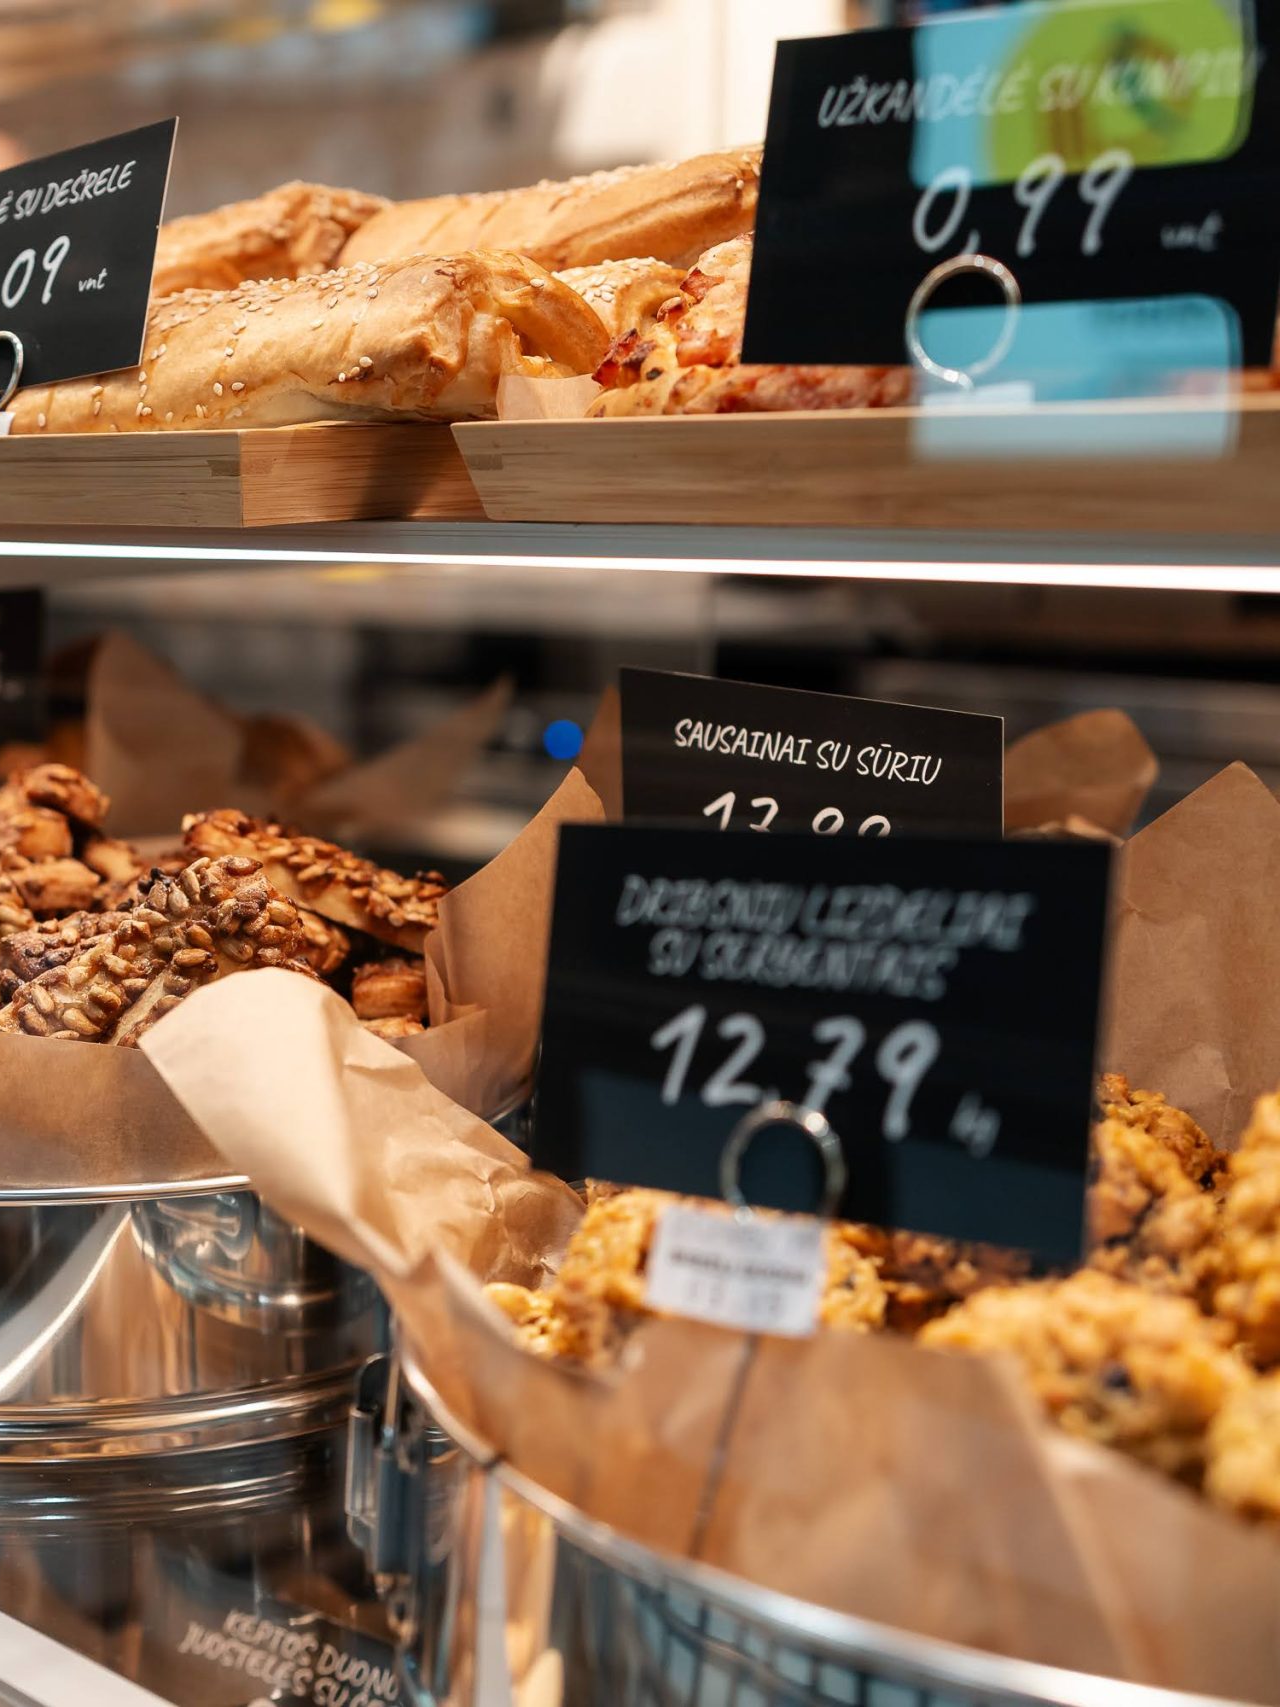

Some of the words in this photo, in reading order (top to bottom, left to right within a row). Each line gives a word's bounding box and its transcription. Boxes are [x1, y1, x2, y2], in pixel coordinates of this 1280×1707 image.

[13, 190, 45, 220] SU
[41, 160, 137, 213] DEŠRELE
[912, 149, 1134, 256] 0,99
[77, 268, 108, 292] vnt
[674, 718, 813, 765] SAUSAINAI
[816, 740, 851, 772] SU
[856, 743, 942, 785] SŪRIU
